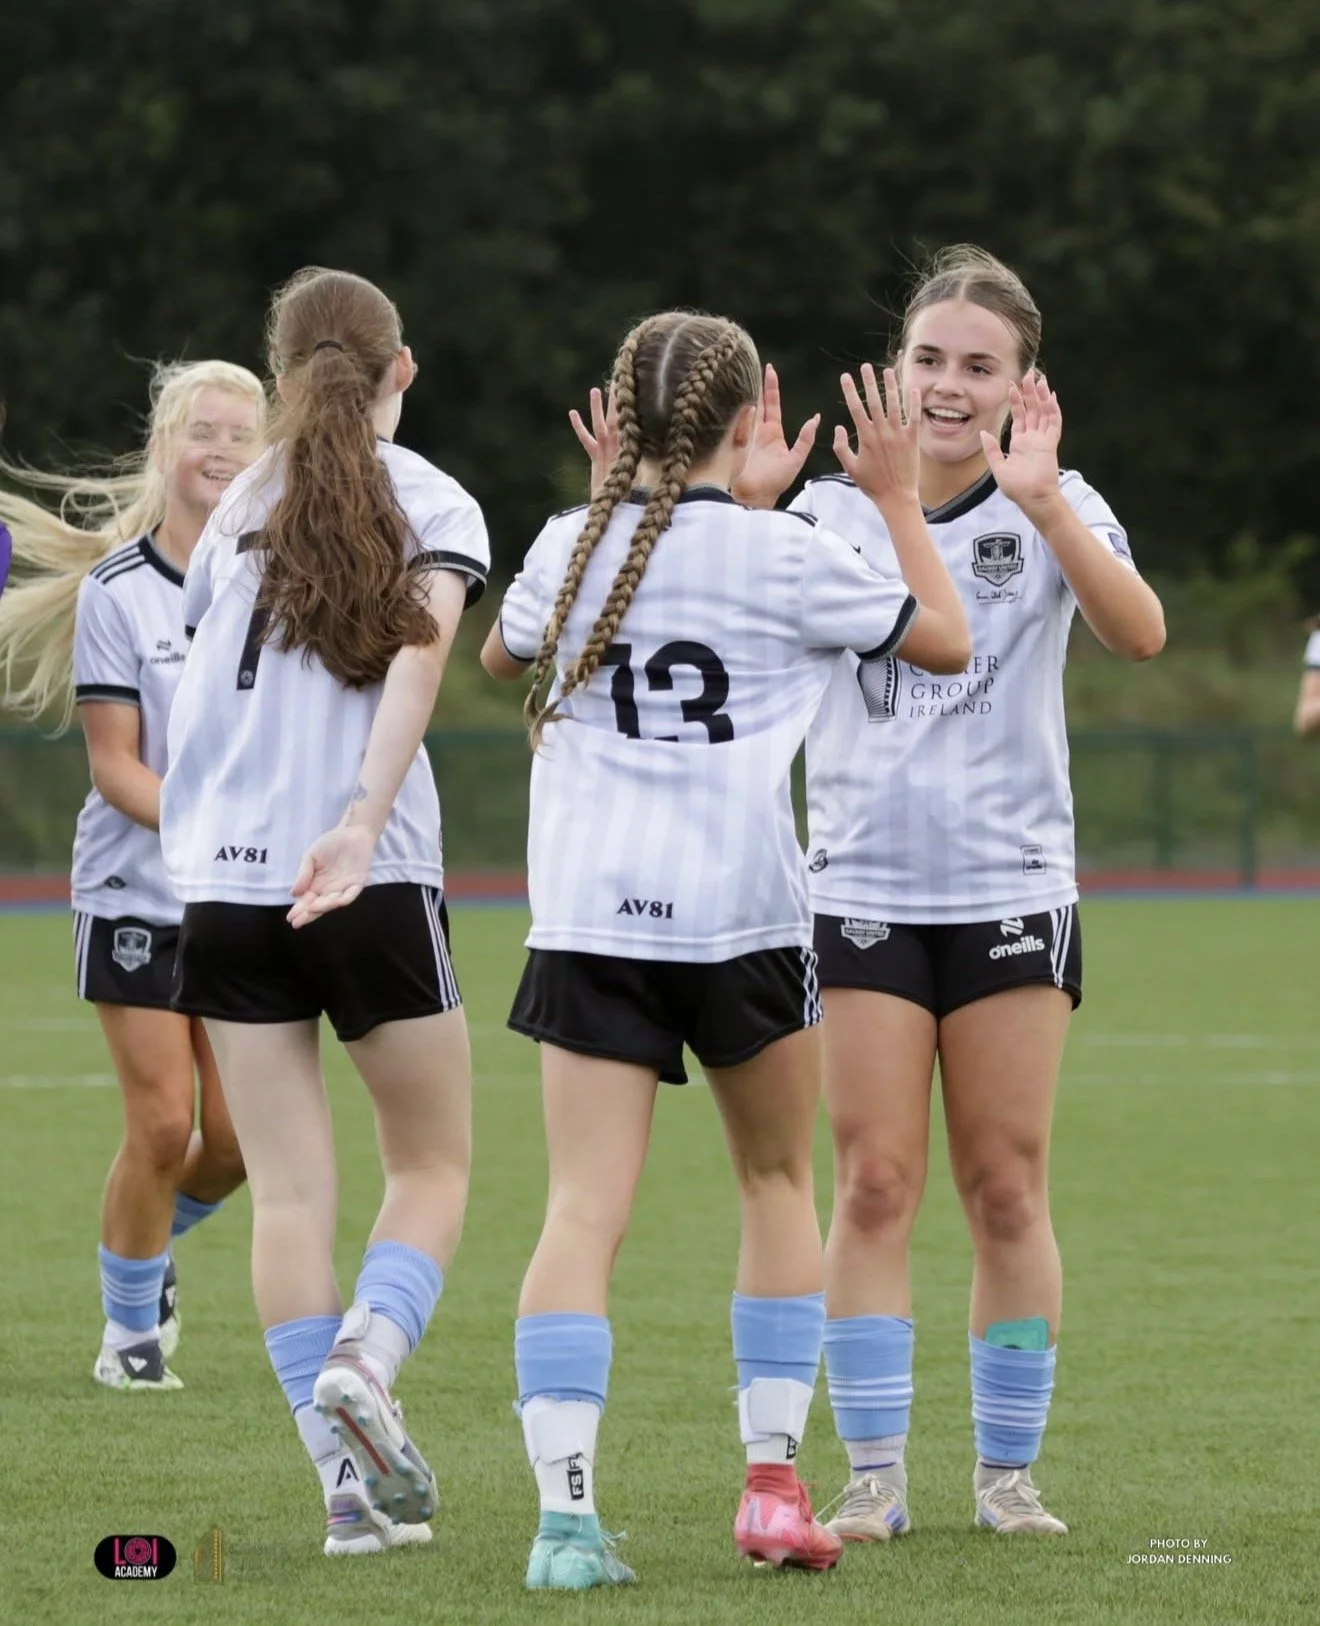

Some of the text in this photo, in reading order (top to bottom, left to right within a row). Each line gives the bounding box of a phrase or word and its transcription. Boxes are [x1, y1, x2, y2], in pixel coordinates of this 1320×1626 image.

[600, 640, 735, 744] 13
[910, 676, 994, 700] GROUP
[909, 701, 992, 718] IRELAND
[213, 846, 268, 865] AV81
[616, 898, 674, 919] AV81
